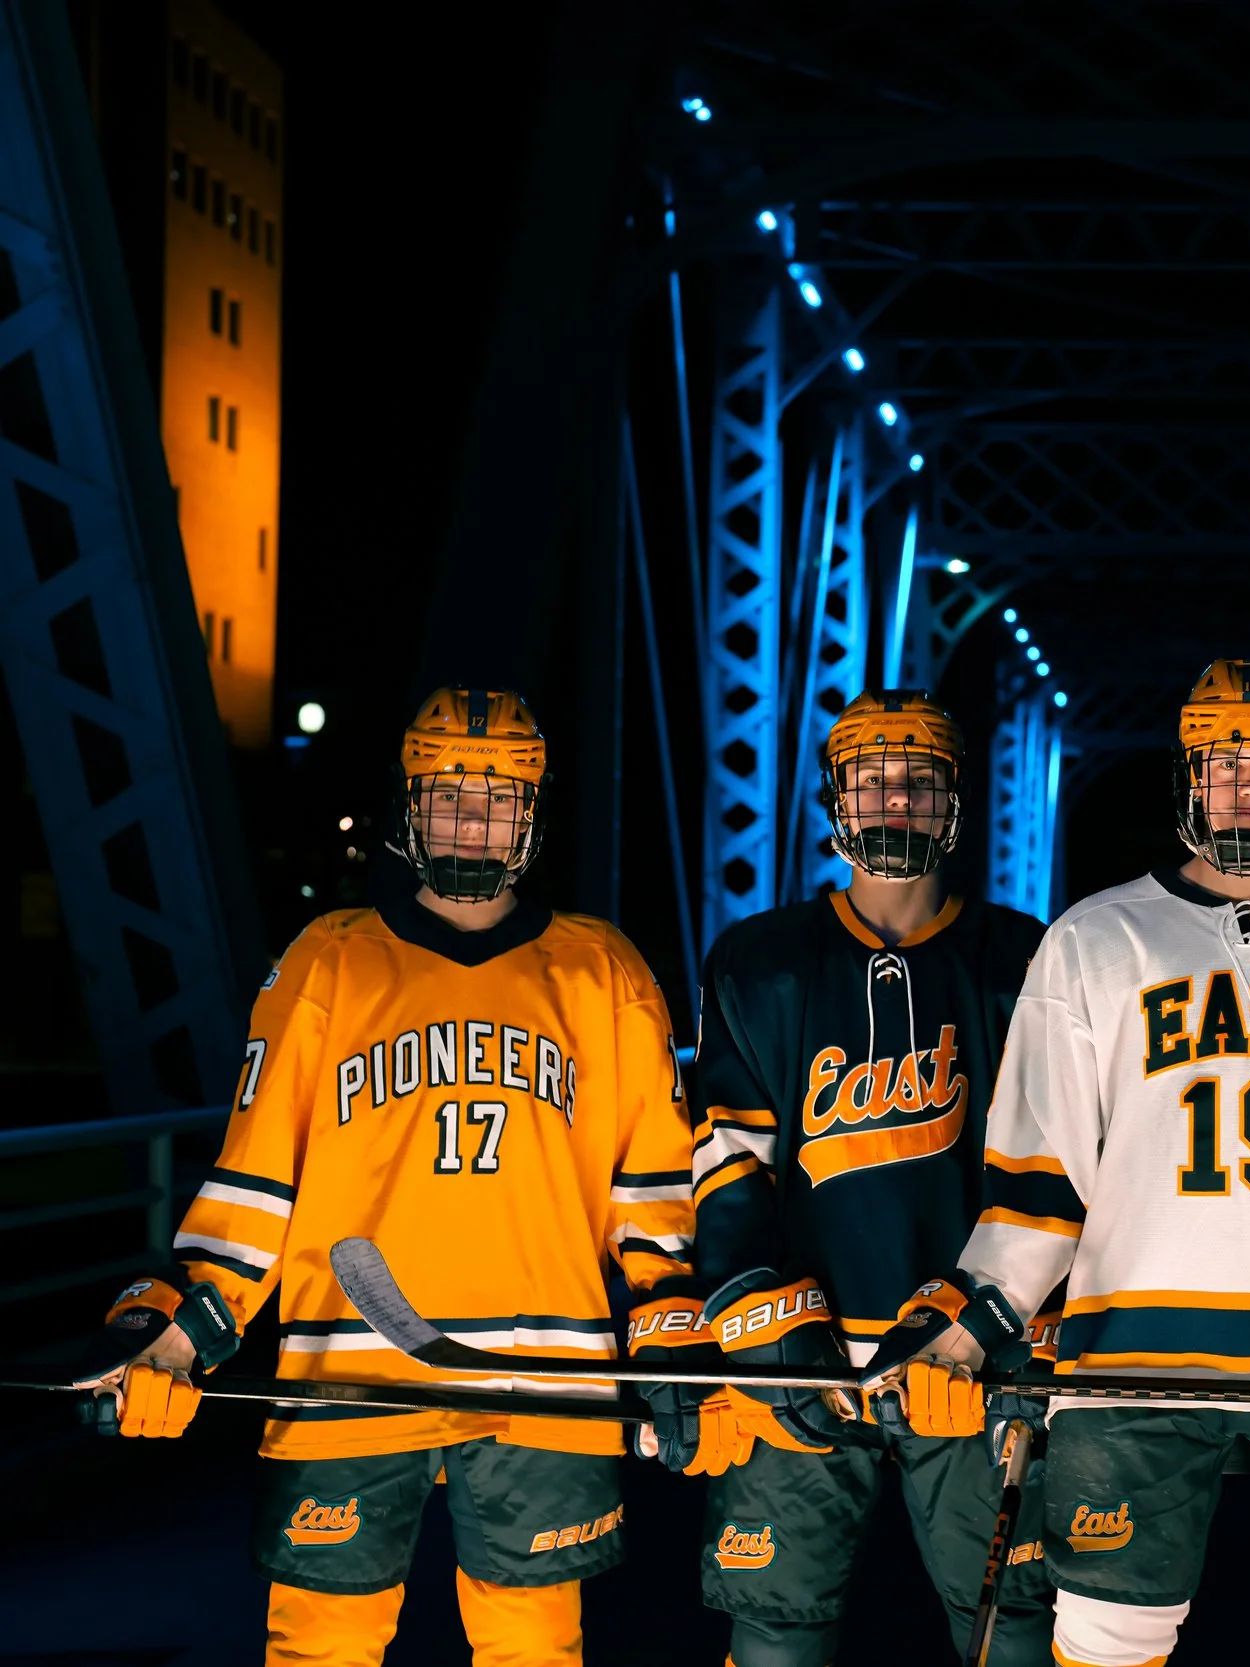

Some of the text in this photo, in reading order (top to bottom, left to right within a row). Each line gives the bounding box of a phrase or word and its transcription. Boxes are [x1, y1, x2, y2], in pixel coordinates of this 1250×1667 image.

[471, 716, 486, 728] 17
[337, 1020, 577, 1129] PIONEERS
[801, 1024, 966, 1140] East
[434, 1101, 508, 1175] 17
[721, 1288, 828, 1344] BAUE
[986, 1299, 1015, 1334] BAUER
[290, 1498, 359, 1529] East
[529, 1503, 625, 1553] BAUER
[1070, 1503, 1130, 1536] East
[718, 1525, 773, 1555] East
